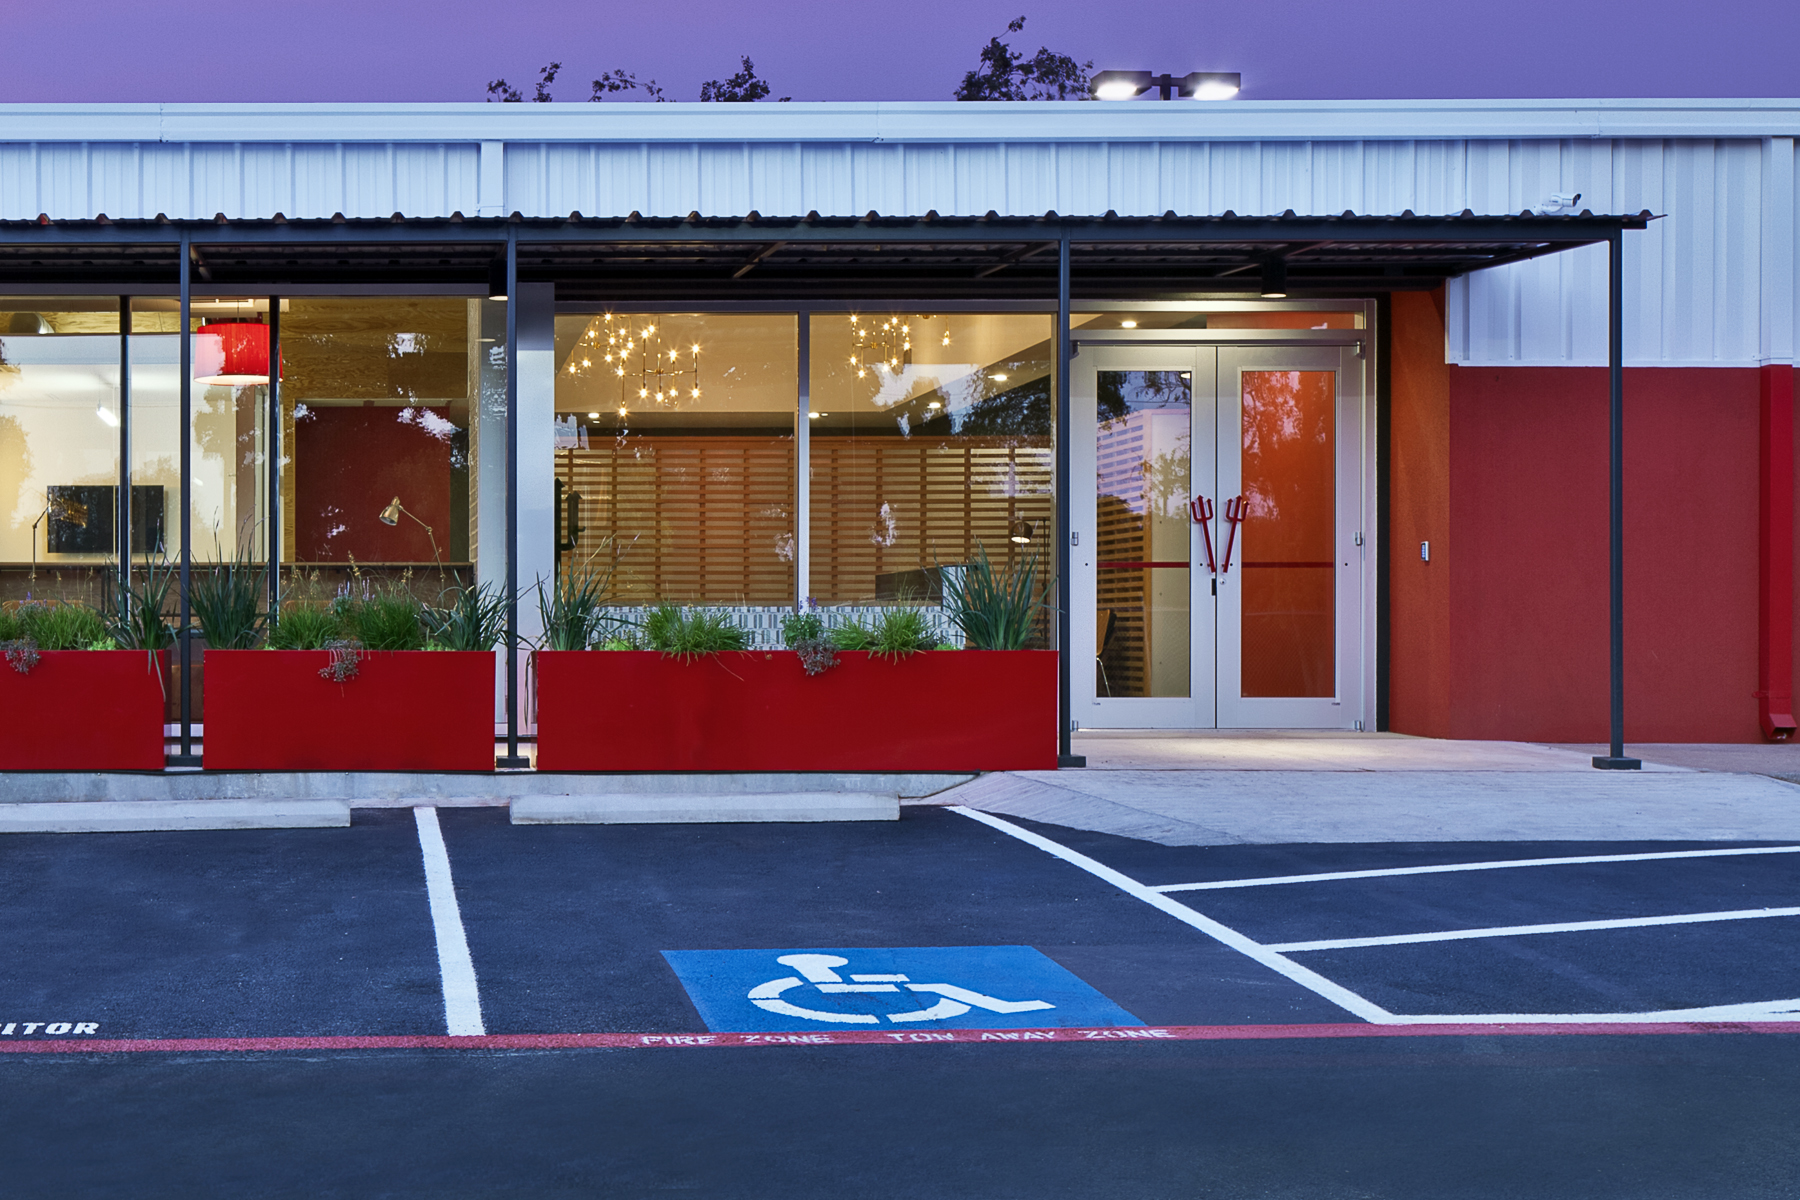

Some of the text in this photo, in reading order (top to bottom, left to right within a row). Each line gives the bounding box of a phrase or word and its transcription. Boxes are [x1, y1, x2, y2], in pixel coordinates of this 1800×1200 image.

[641, 1029, 1177, 1045] FIRE ZONE TOW AWAY ZONE
